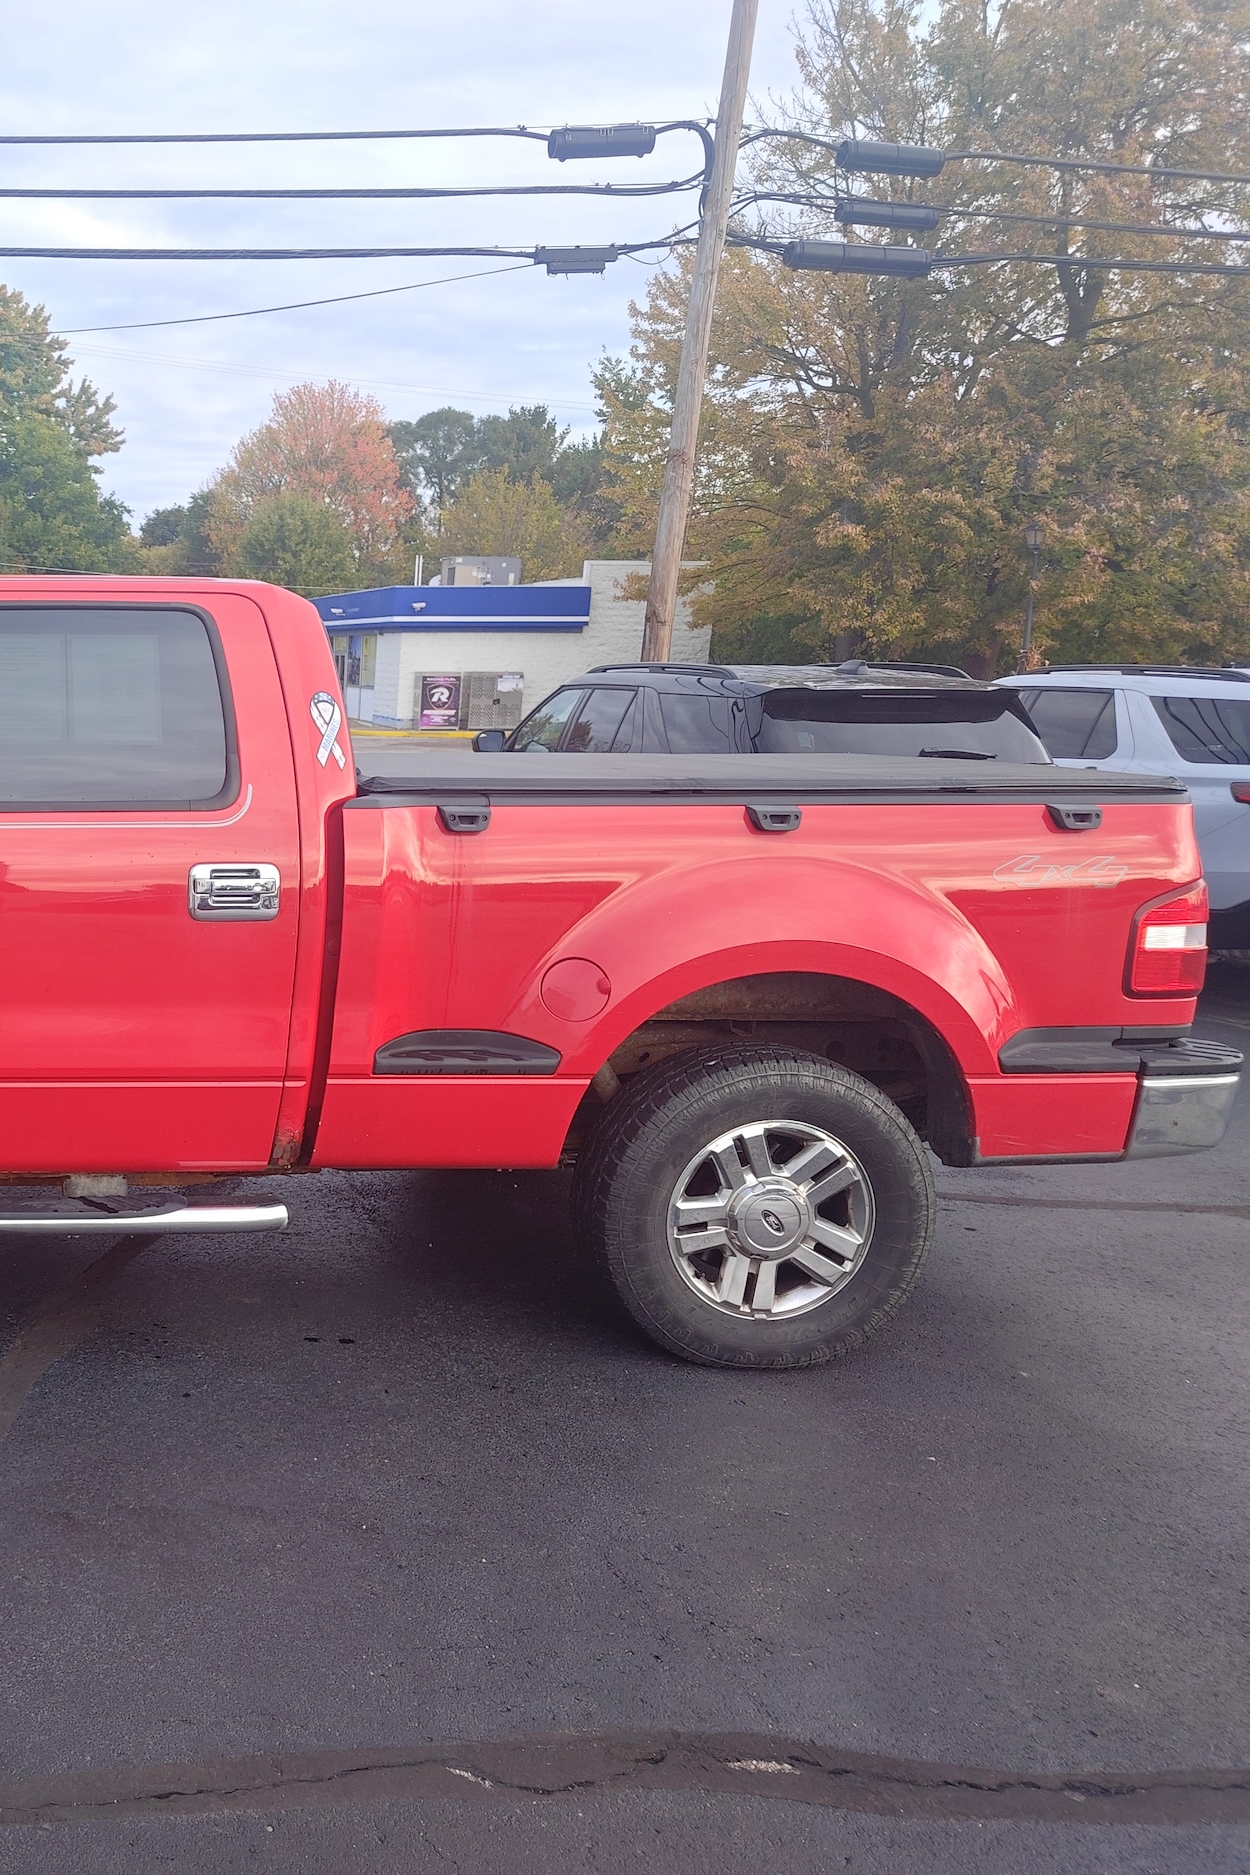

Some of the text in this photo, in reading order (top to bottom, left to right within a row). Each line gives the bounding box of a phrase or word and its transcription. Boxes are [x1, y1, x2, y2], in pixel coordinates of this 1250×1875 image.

[430, 687, 450, 702] R
[321, 719, 340, 752] MARINES
[993, 854, 1129, 888] 4x4
